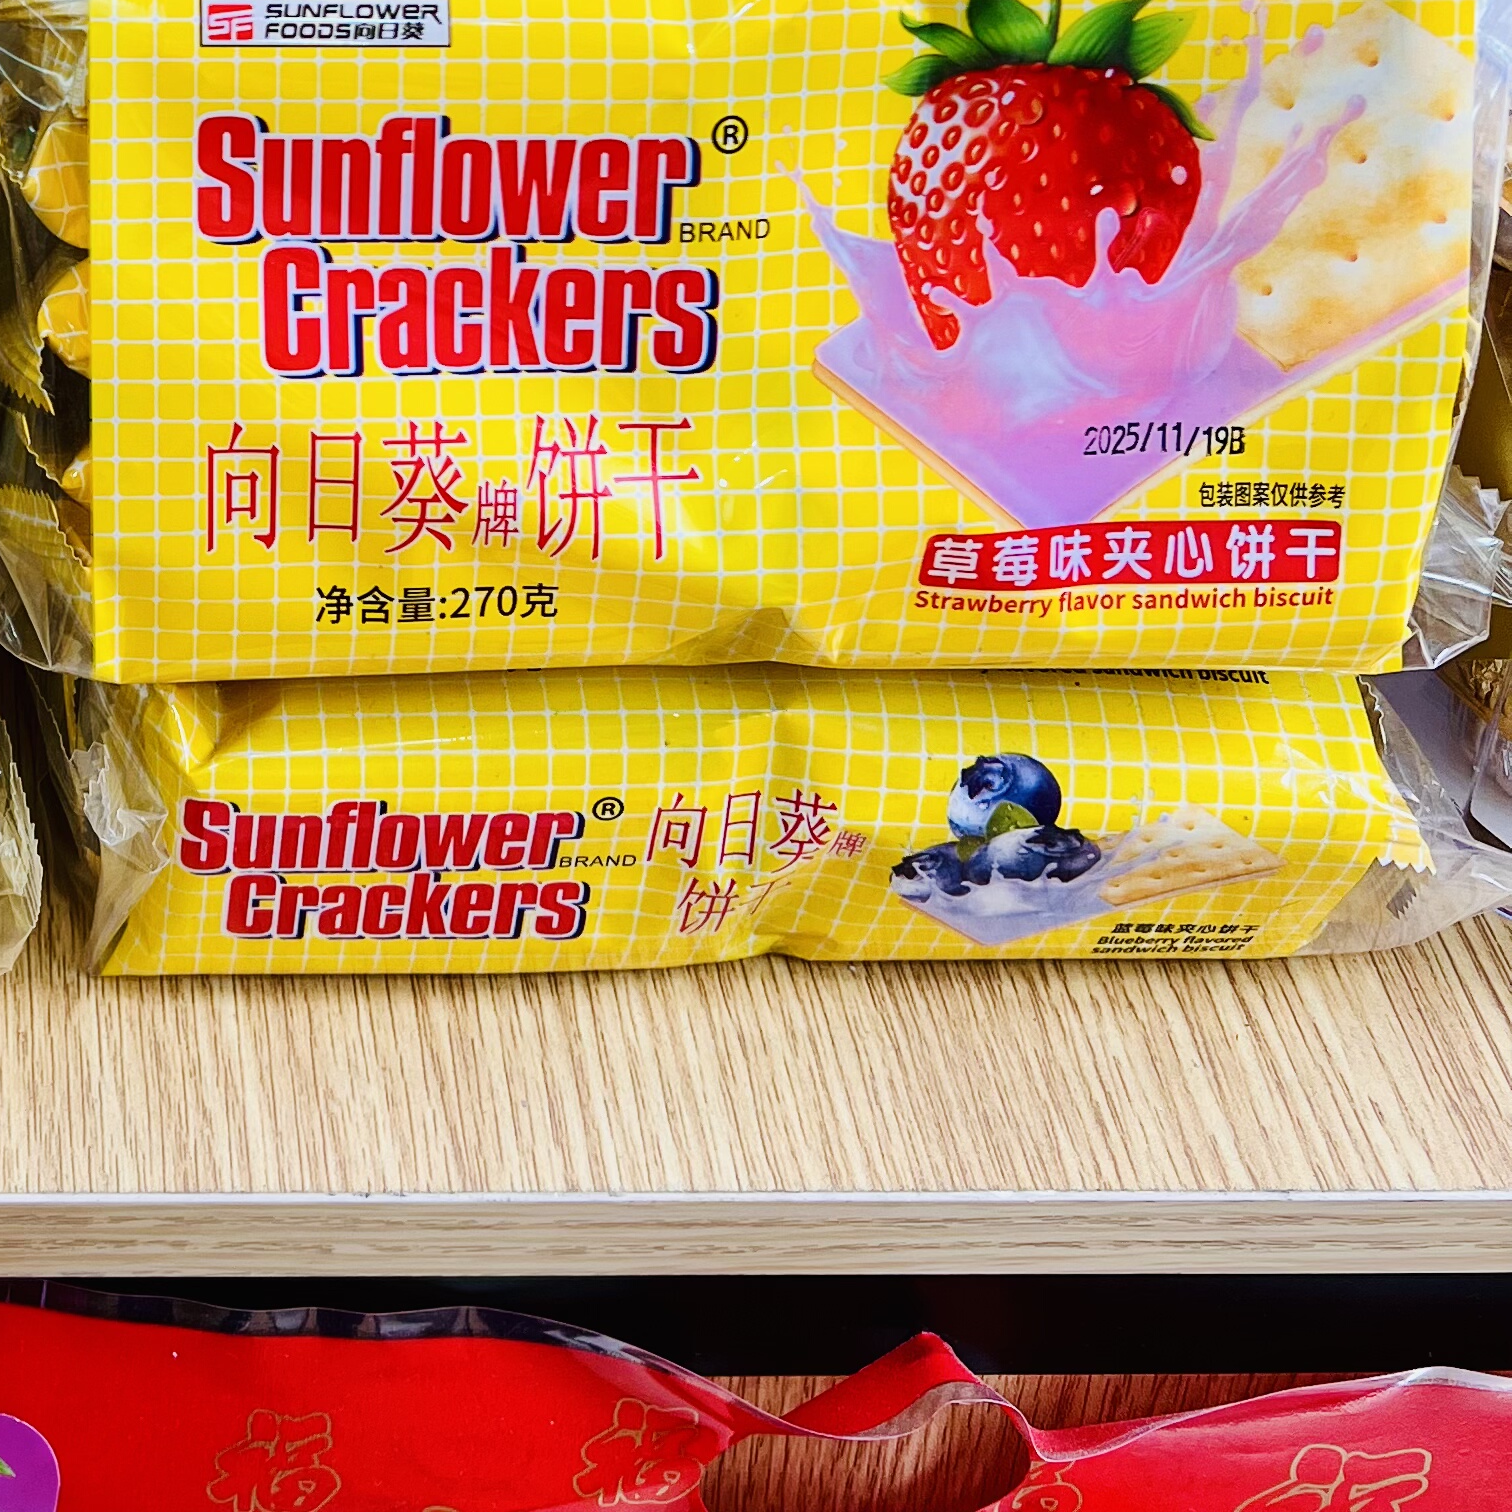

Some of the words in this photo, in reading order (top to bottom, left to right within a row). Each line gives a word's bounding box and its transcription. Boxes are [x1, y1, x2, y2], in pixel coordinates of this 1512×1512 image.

[264, 3, 443, 24] SUNFLOWER
[194, 111, 702, 245] Sunflower
[679, 218, 771, 243] BRAND
[261, 241, 719, 377] Crackers
[1083, 421, 1247, 458] 2025/11/19B
[205, 413, 700, 561] 向日葵牌饼干
[1198, 481, 1346, 510] 包装图案仅供参考
[927, 523, 1338, 589] 草莓味夹心饼干
[315, 583, 560, 627] 净含量:270克
[914, 589, 1053, 618] Strawberry
[1058, 588, 1126, 614] flavor
[1132, 587, 1247, 611] sandwich
[1253, 586, 1335, 609] biscuit
[180, 797, 585, 874] Sunflower
[646, 788, 869, 875] 向日葵牌
[558, 853, 637, 869] BRAND
[222, 871, 590, 940] Crackers
[676, 876, 792, 936] 饼干
[1091, 944, 1179, 955] sandwich
[1181, 943, 1246, 953] biscuit
[1097, 935, 1181, 946] Blueberry
[1183, 935, 1254, 945] flavored
